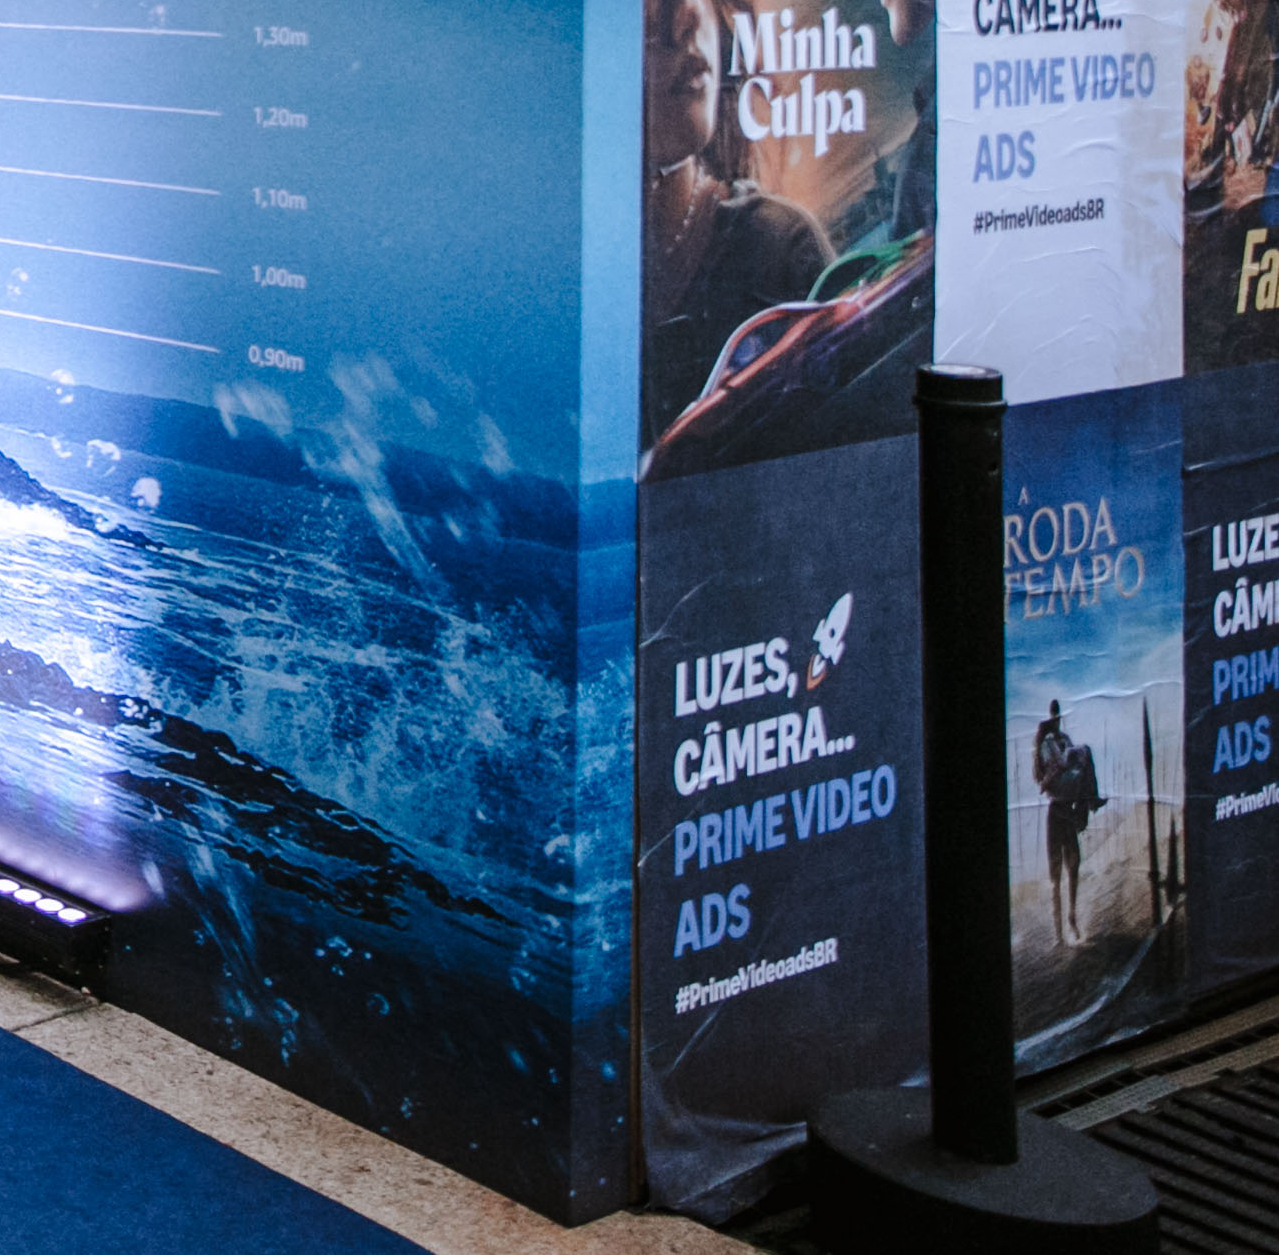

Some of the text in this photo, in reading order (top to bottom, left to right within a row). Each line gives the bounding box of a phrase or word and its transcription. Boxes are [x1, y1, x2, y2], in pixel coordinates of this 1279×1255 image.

[254, 26, 309, 47] 1,30m
[727, 6, 877, 76] Minha
[973, 52, 1156, 110] PRIME VIDEO
[254, 106, 308, 128] 1,20m
[738, 73, 866, 158] Culpa
[973, 130, 1036, 183] ADS
[252, 187, 308, 210] 1,10m
[973, 197, 1105, 235] #PrimeVideoadsBR
[252, 264, 307, 289] 1,00m
[248, 344, 305, 371] 0,90m
[1017, 486, 1029, 505] A
[1004, 497, 1118, 569] RODA
[675, 637, 798, 718] LUZES,
[674, 706, 856, 796] CÂMERA...
[1212, 715, 1272, 775] ADS
[674, 764, 898, 877] PRIME VIDEO
[673, 883, 752, 959] ADS
[675, 937, 839, 1015] #PrimeVideoadsBR
